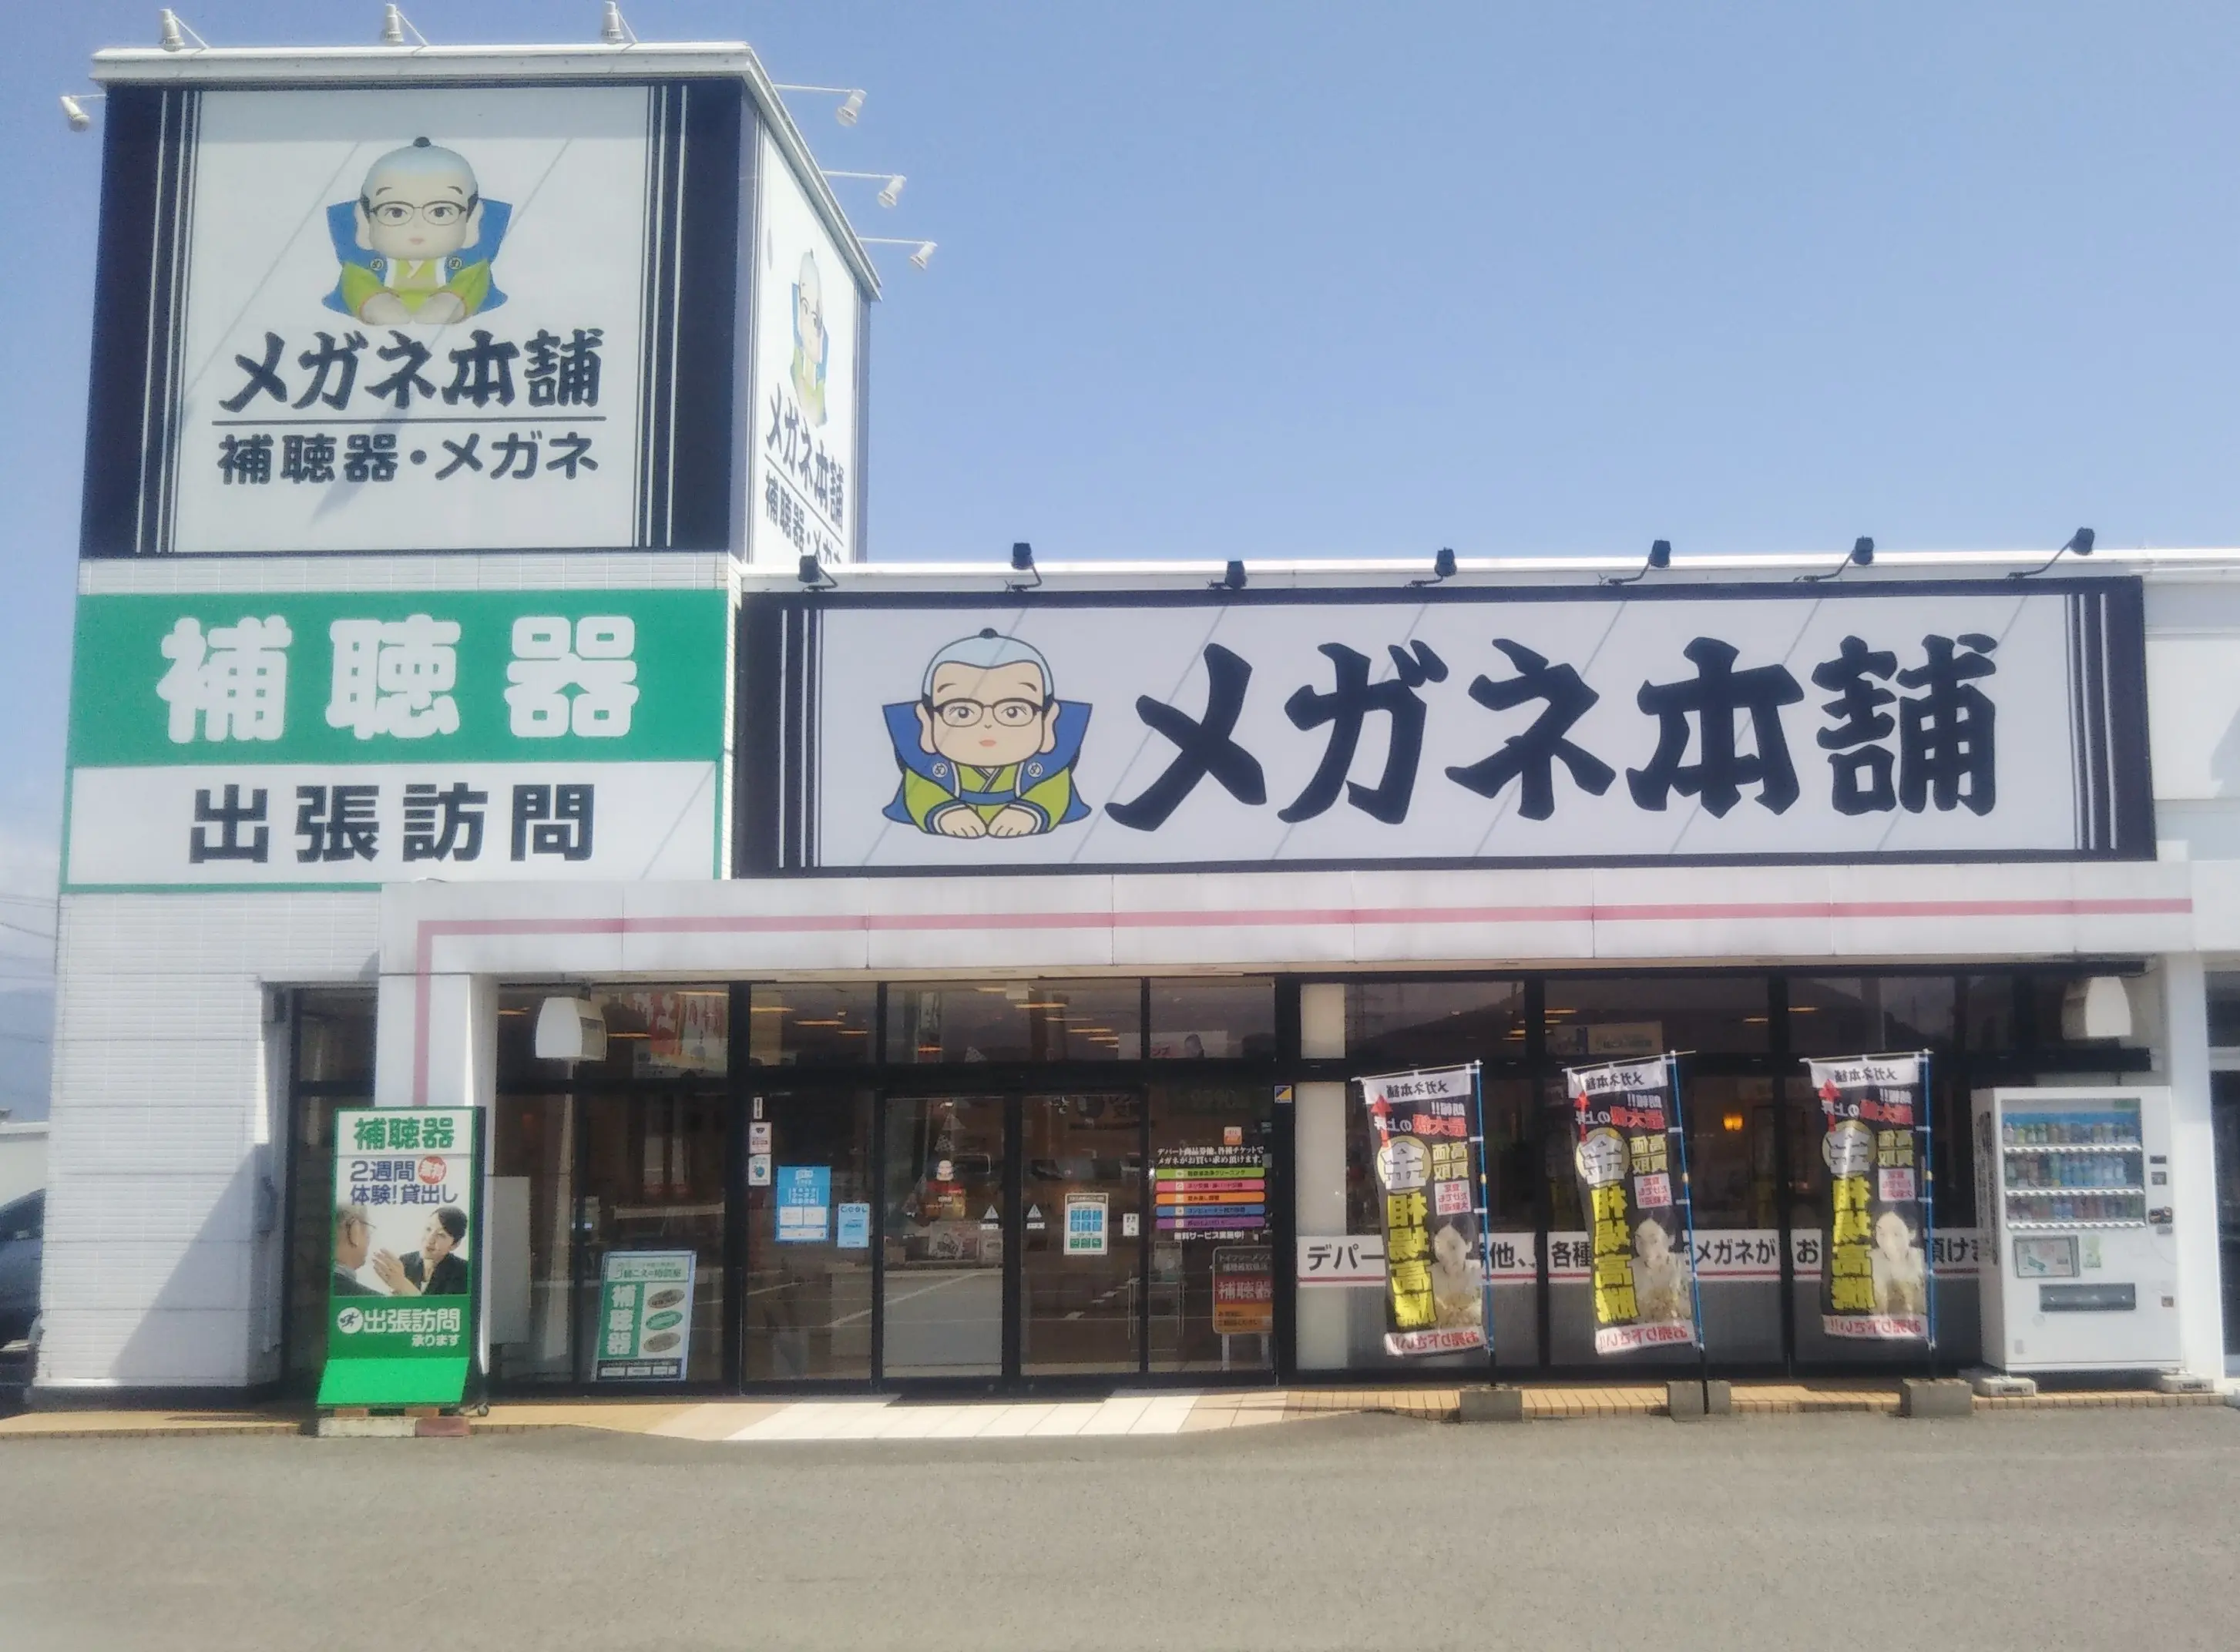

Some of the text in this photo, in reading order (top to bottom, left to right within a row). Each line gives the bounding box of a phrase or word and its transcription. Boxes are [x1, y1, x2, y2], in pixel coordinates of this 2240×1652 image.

[219, 327, 605, 413] メガネ本舗
[218, 431, 599, 485] 補聴器・メガネ
[766, 382, 844, 534] メガネ本舗
[156, 613, 640, 744] 補聴器
[1103, 633, 1998, 831] メガネ本舗
[189, 781, 595, 864] 出張訪問
[354, 1116, 455, 1150] 補聴器
[350, 1160, 416, 1183] 2週間
[1684, 1238, 1776, 1265] メガネが
[1795, 1238, 1819, 1264] お
[1217, 1281, 1271, 1300] 補聴器
[363, 1308, 461, 1333] 出張訪問
[411, 1334, 460, 1348] 承ります
